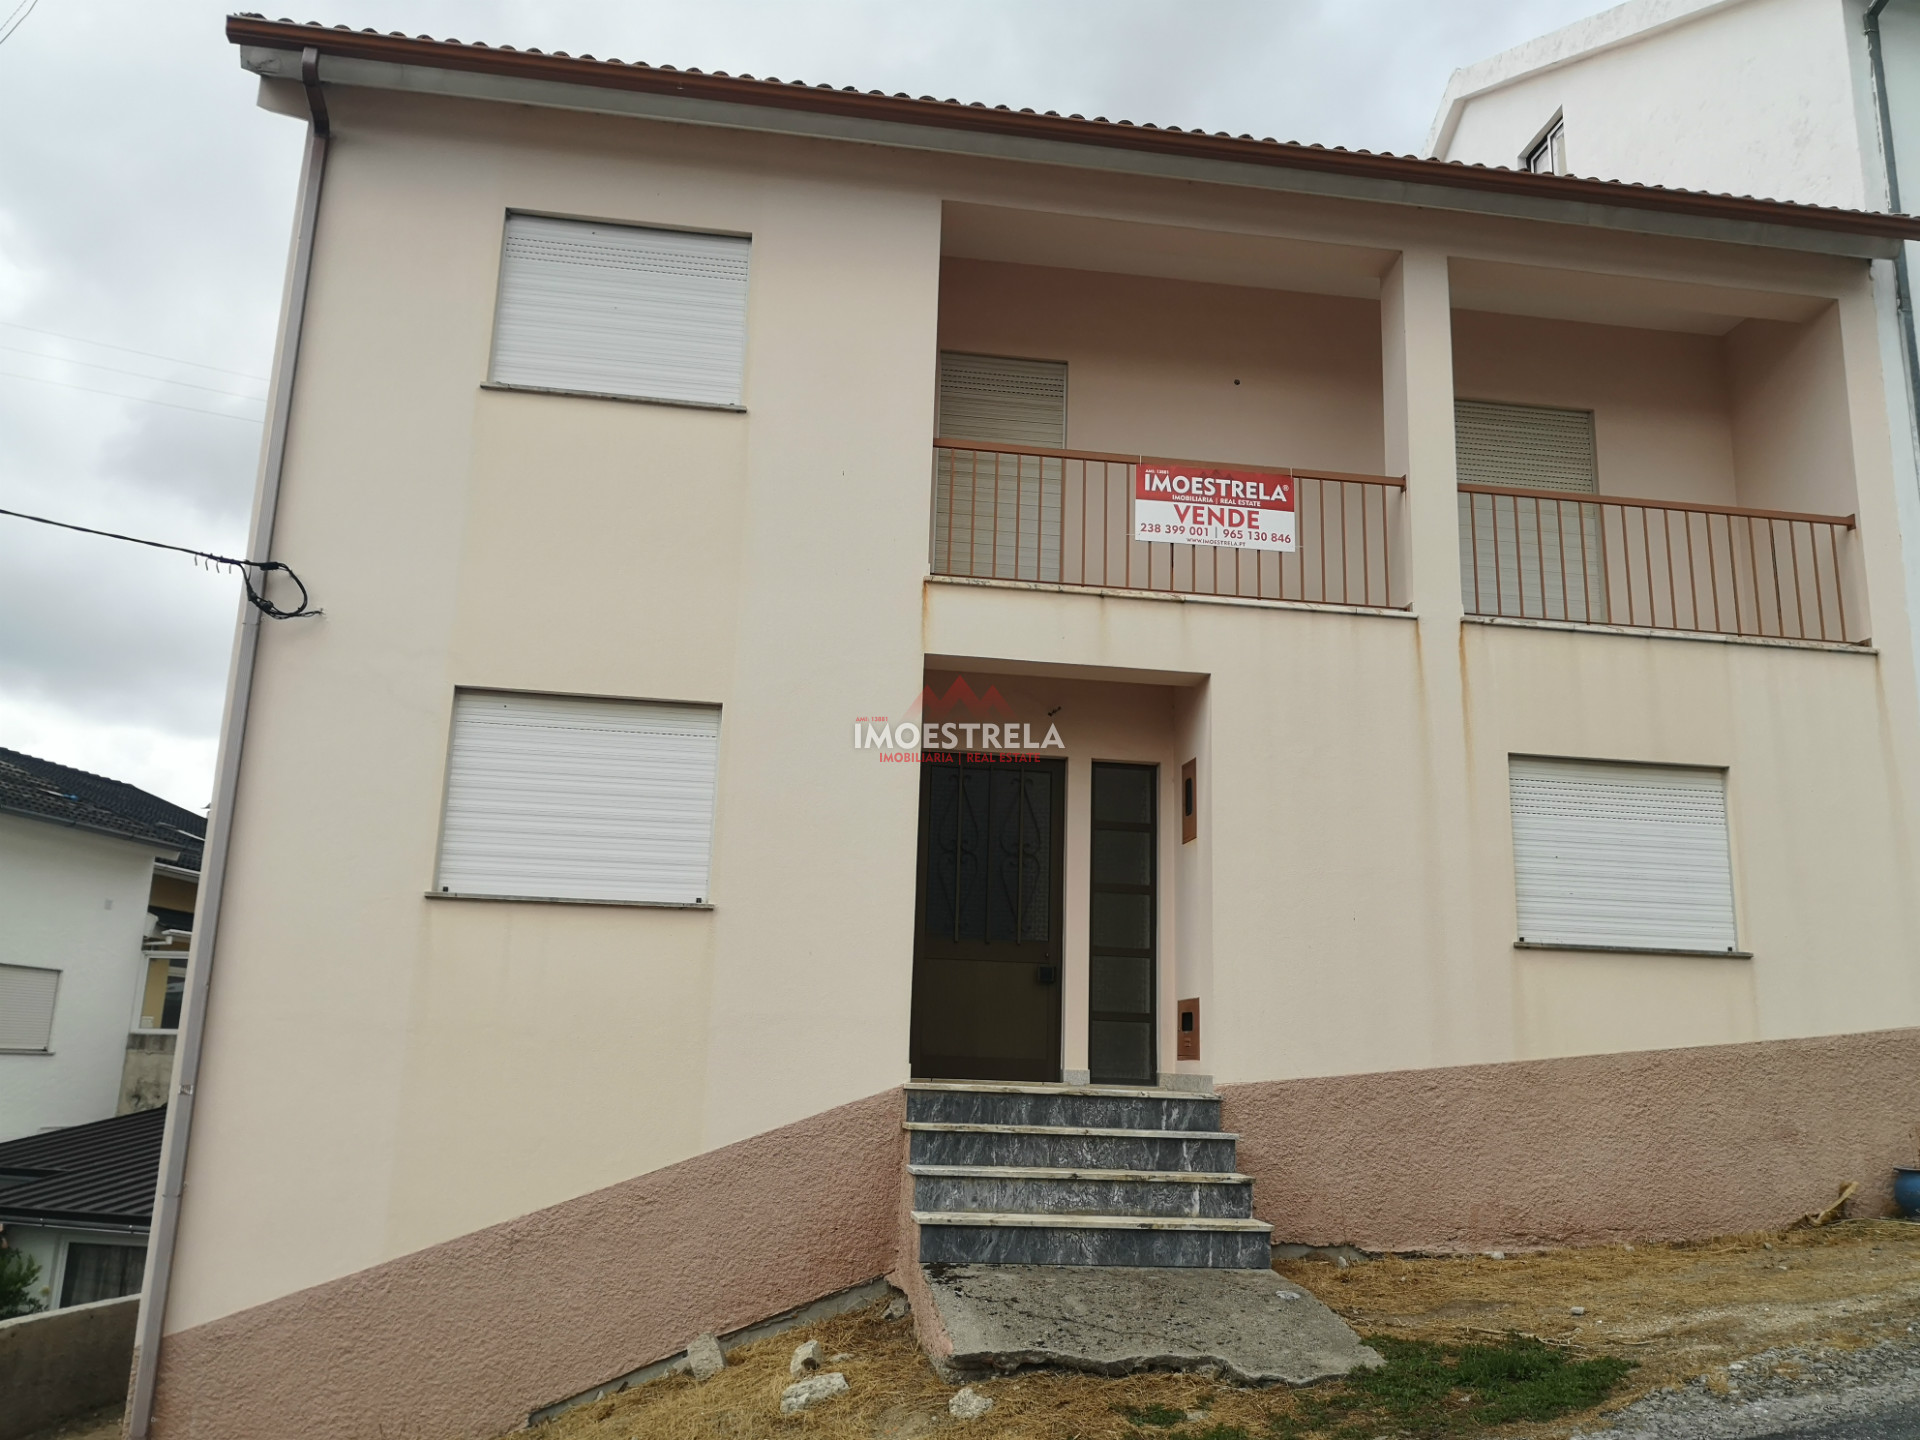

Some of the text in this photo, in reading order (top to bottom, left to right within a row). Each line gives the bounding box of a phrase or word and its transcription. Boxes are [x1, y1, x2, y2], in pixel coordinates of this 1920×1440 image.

[1174, 504, 1260, 530] VENDE
[1140, 522, 1291, 544] 238 399 001 965 130 846
